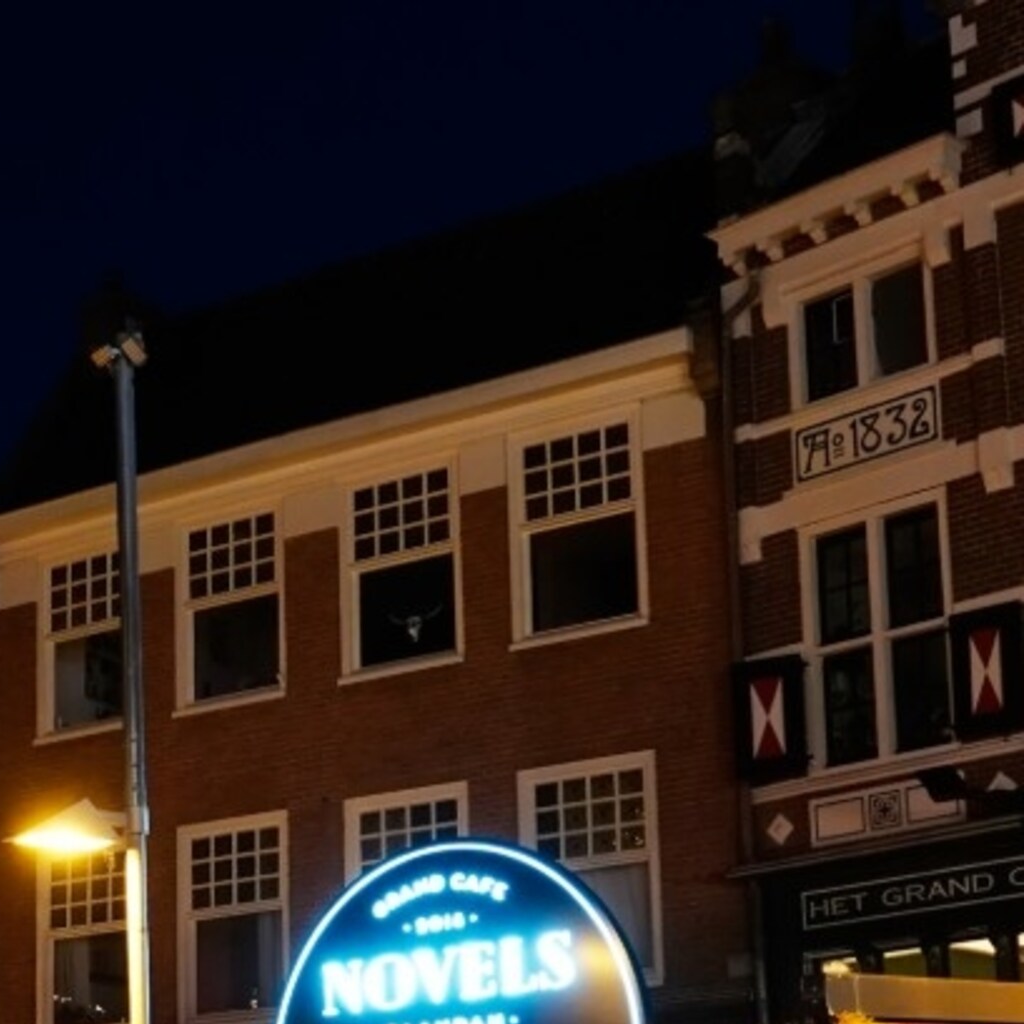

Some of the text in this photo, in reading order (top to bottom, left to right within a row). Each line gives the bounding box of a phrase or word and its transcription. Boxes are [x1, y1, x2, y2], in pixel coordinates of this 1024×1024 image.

[849, 398, 930, 458] 1832
[371, 873, 447, 919] GRAND
[809, 891, 868, 919] HET
[881, 872, 995, 907] GRAND
[321, 930, 578, 1017] NOVELS
